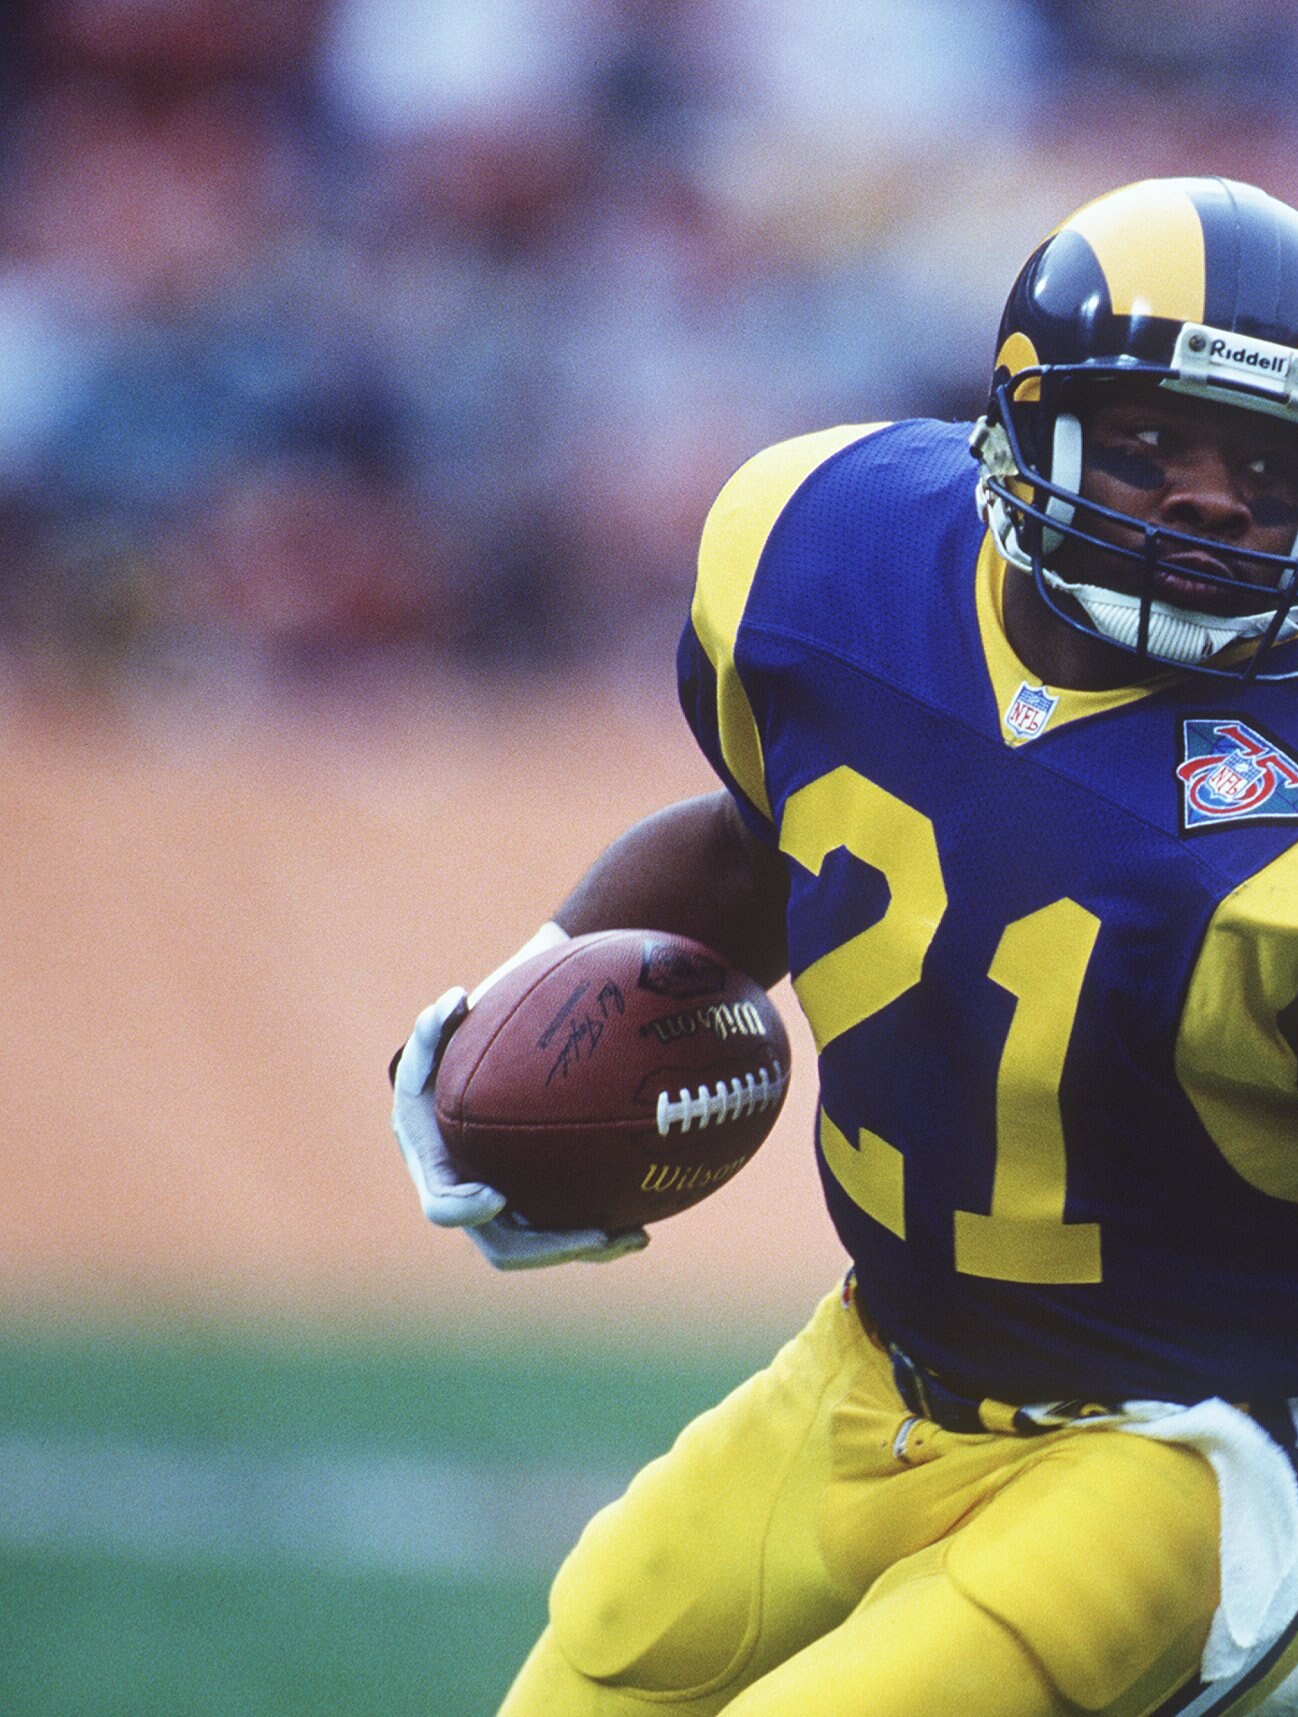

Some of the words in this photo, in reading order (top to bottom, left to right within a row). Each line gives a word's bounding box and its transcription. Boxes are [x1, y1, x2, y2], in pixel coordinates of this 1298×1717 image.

[1210, 338, 1285, 373] Riddell
[1009, 702, 1039, 731] NFL
[1210, 765, 1243, 795] NFL
[651, 1000, 767, 1043] Wilson
[779, 764, 1103, 1284] 21
